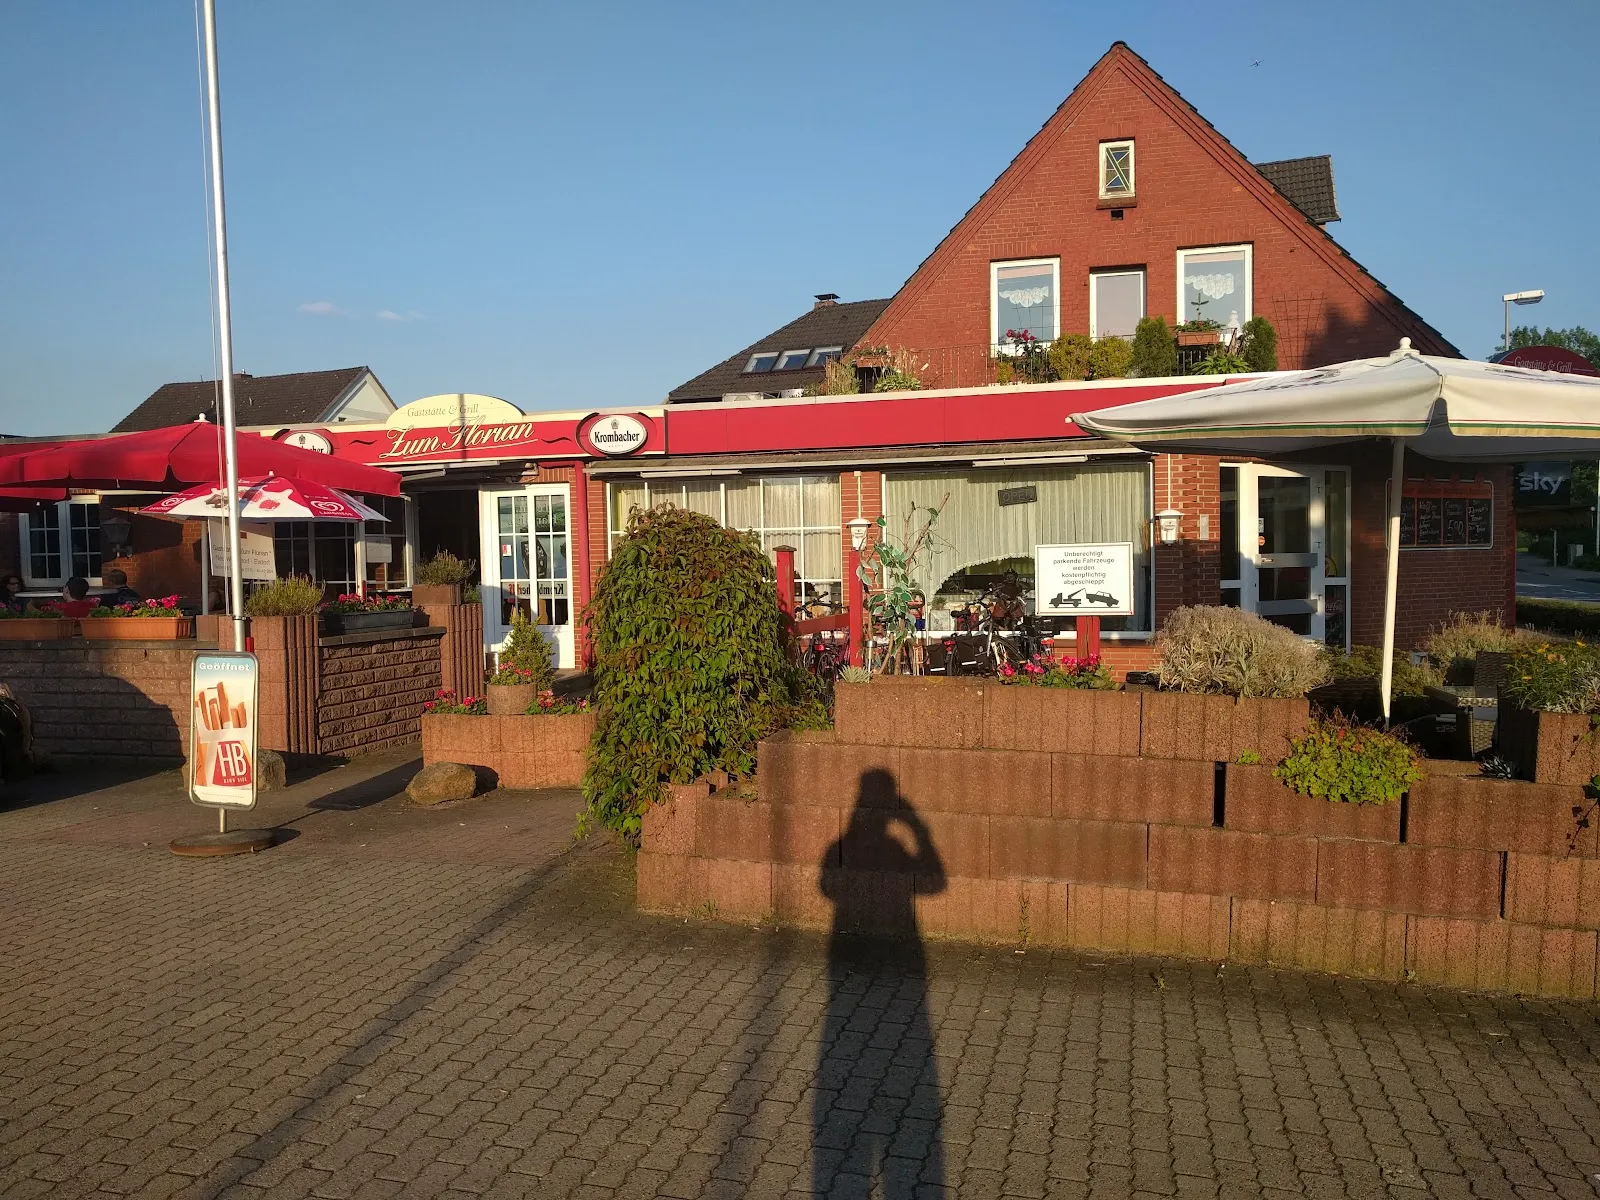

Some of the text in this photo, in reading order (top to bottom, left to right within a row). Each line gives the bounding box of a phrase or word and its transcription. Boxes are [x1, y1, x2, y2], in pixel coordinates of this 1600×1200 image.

[1556, 361, 1573, 373] Grill
[407, 403, 479, 417] Gaststätte & Grill
[379, 414, 534, 458] Zum Florian
[594, 430, 640, 443] Krombacher
[1519, 471, 1564, 495] sky
[1002, 489, 1033, 502] OPEN
[199, 662, 250, 672] Geöffnet
[218, 743, 247, 777] HB
